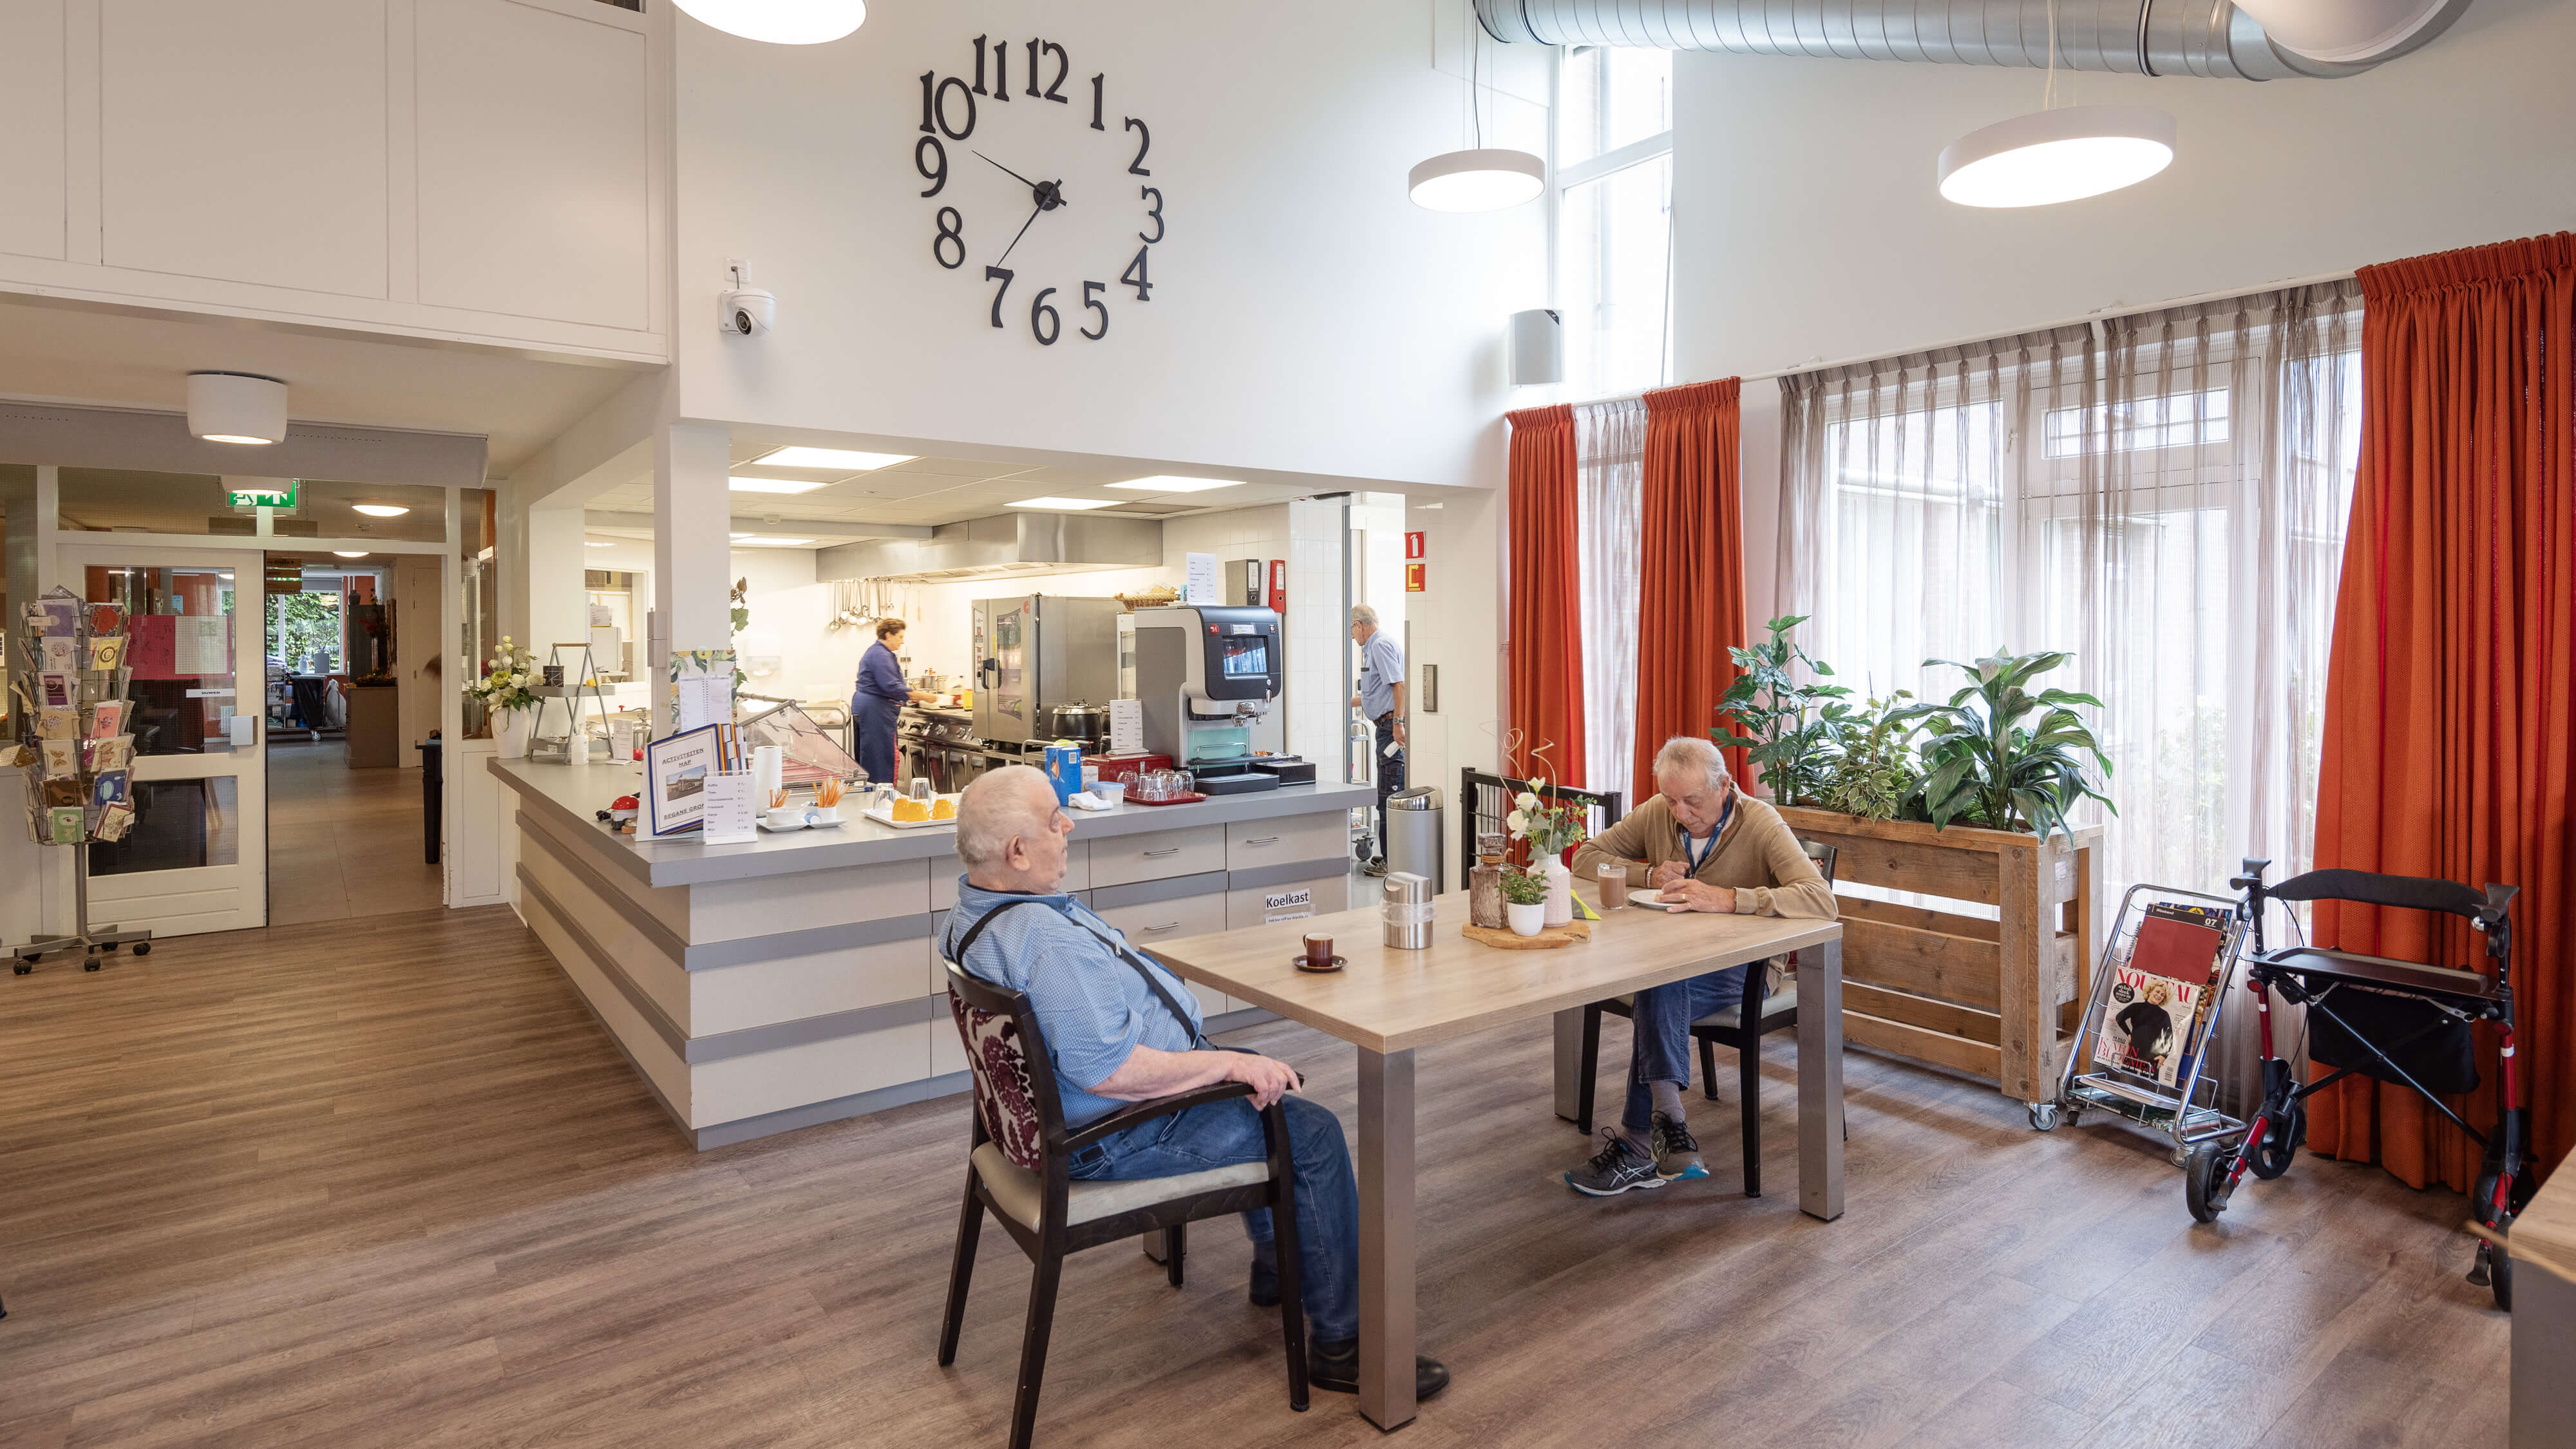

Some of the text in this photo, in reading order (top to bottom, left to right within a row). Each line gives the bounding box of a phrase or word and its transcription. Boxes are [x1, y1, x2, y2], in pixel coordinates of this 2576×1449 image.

[972, 33, 1009, 102] 11
[1026, 37, 1068, 104] 12
[919, 70, 976, 140] 10
[1090, 72, 1104, 131] 1
[915, 135, 947, 198] 9
[1124, 116, 1150, 176] 2
[934, 206, 965, 269] 8
[1139, 185, 1164, 243] 3
[986, 265, 1014, 328] 7
[1121, 244, 1153, 301] 4
[1032, 287, 1060, 345] 6
[1081, 280, 1108, 340] 5
[662, 748, 704, 764] ACTIVITEITEN
[664, 808, 688, 819] BEGANE
[1266, 892, 1309, 908] Koelkast
[2204, 918, 2217, 926] 07
[2100, 1037, 2140, 1057] KARIN
